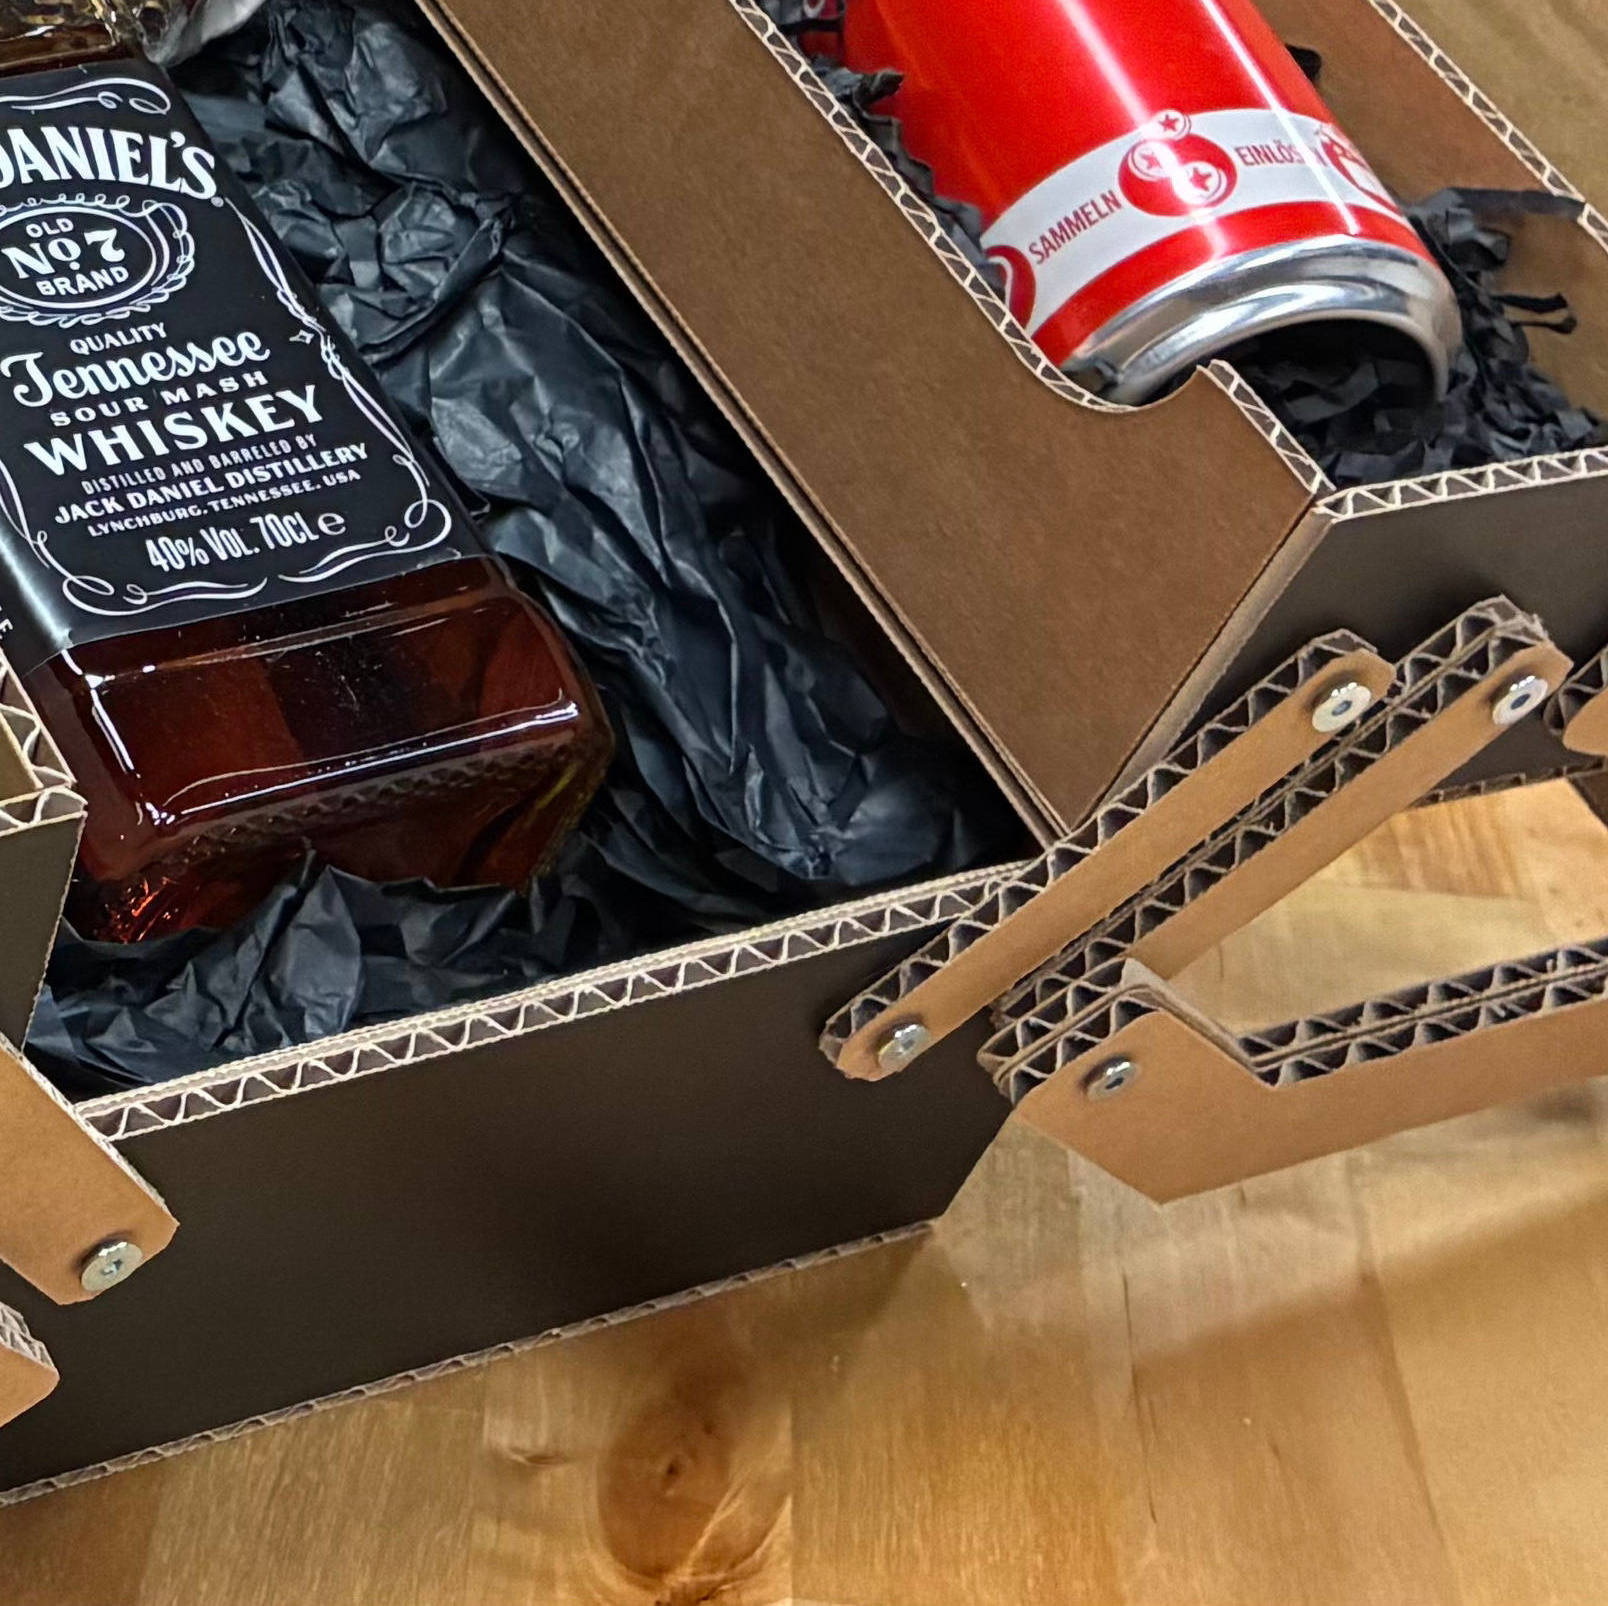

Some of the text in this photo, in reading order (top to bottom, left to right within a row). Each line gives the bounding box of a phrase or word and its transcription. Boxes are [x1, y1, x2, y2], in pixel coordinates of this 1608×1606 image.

[24, 217, 75, 239] OLD
[1028, 188, 1123, 265] SAMMELN
[35, 265, 130, 297] BRAND
[69, 321, 168, 355] QUALITY
[49, 370, 269, 427] SOUR MASH
[23, 384, 324, 477] WHISKEY
[54, 442, 369, 526] JACK DANIEL DISTILLERY
[80, 433, 318, 496] DISTILLED AND BARRELED BY
[323, 469, 362, 488] USA
[145, 535, 211, 573] 40%
